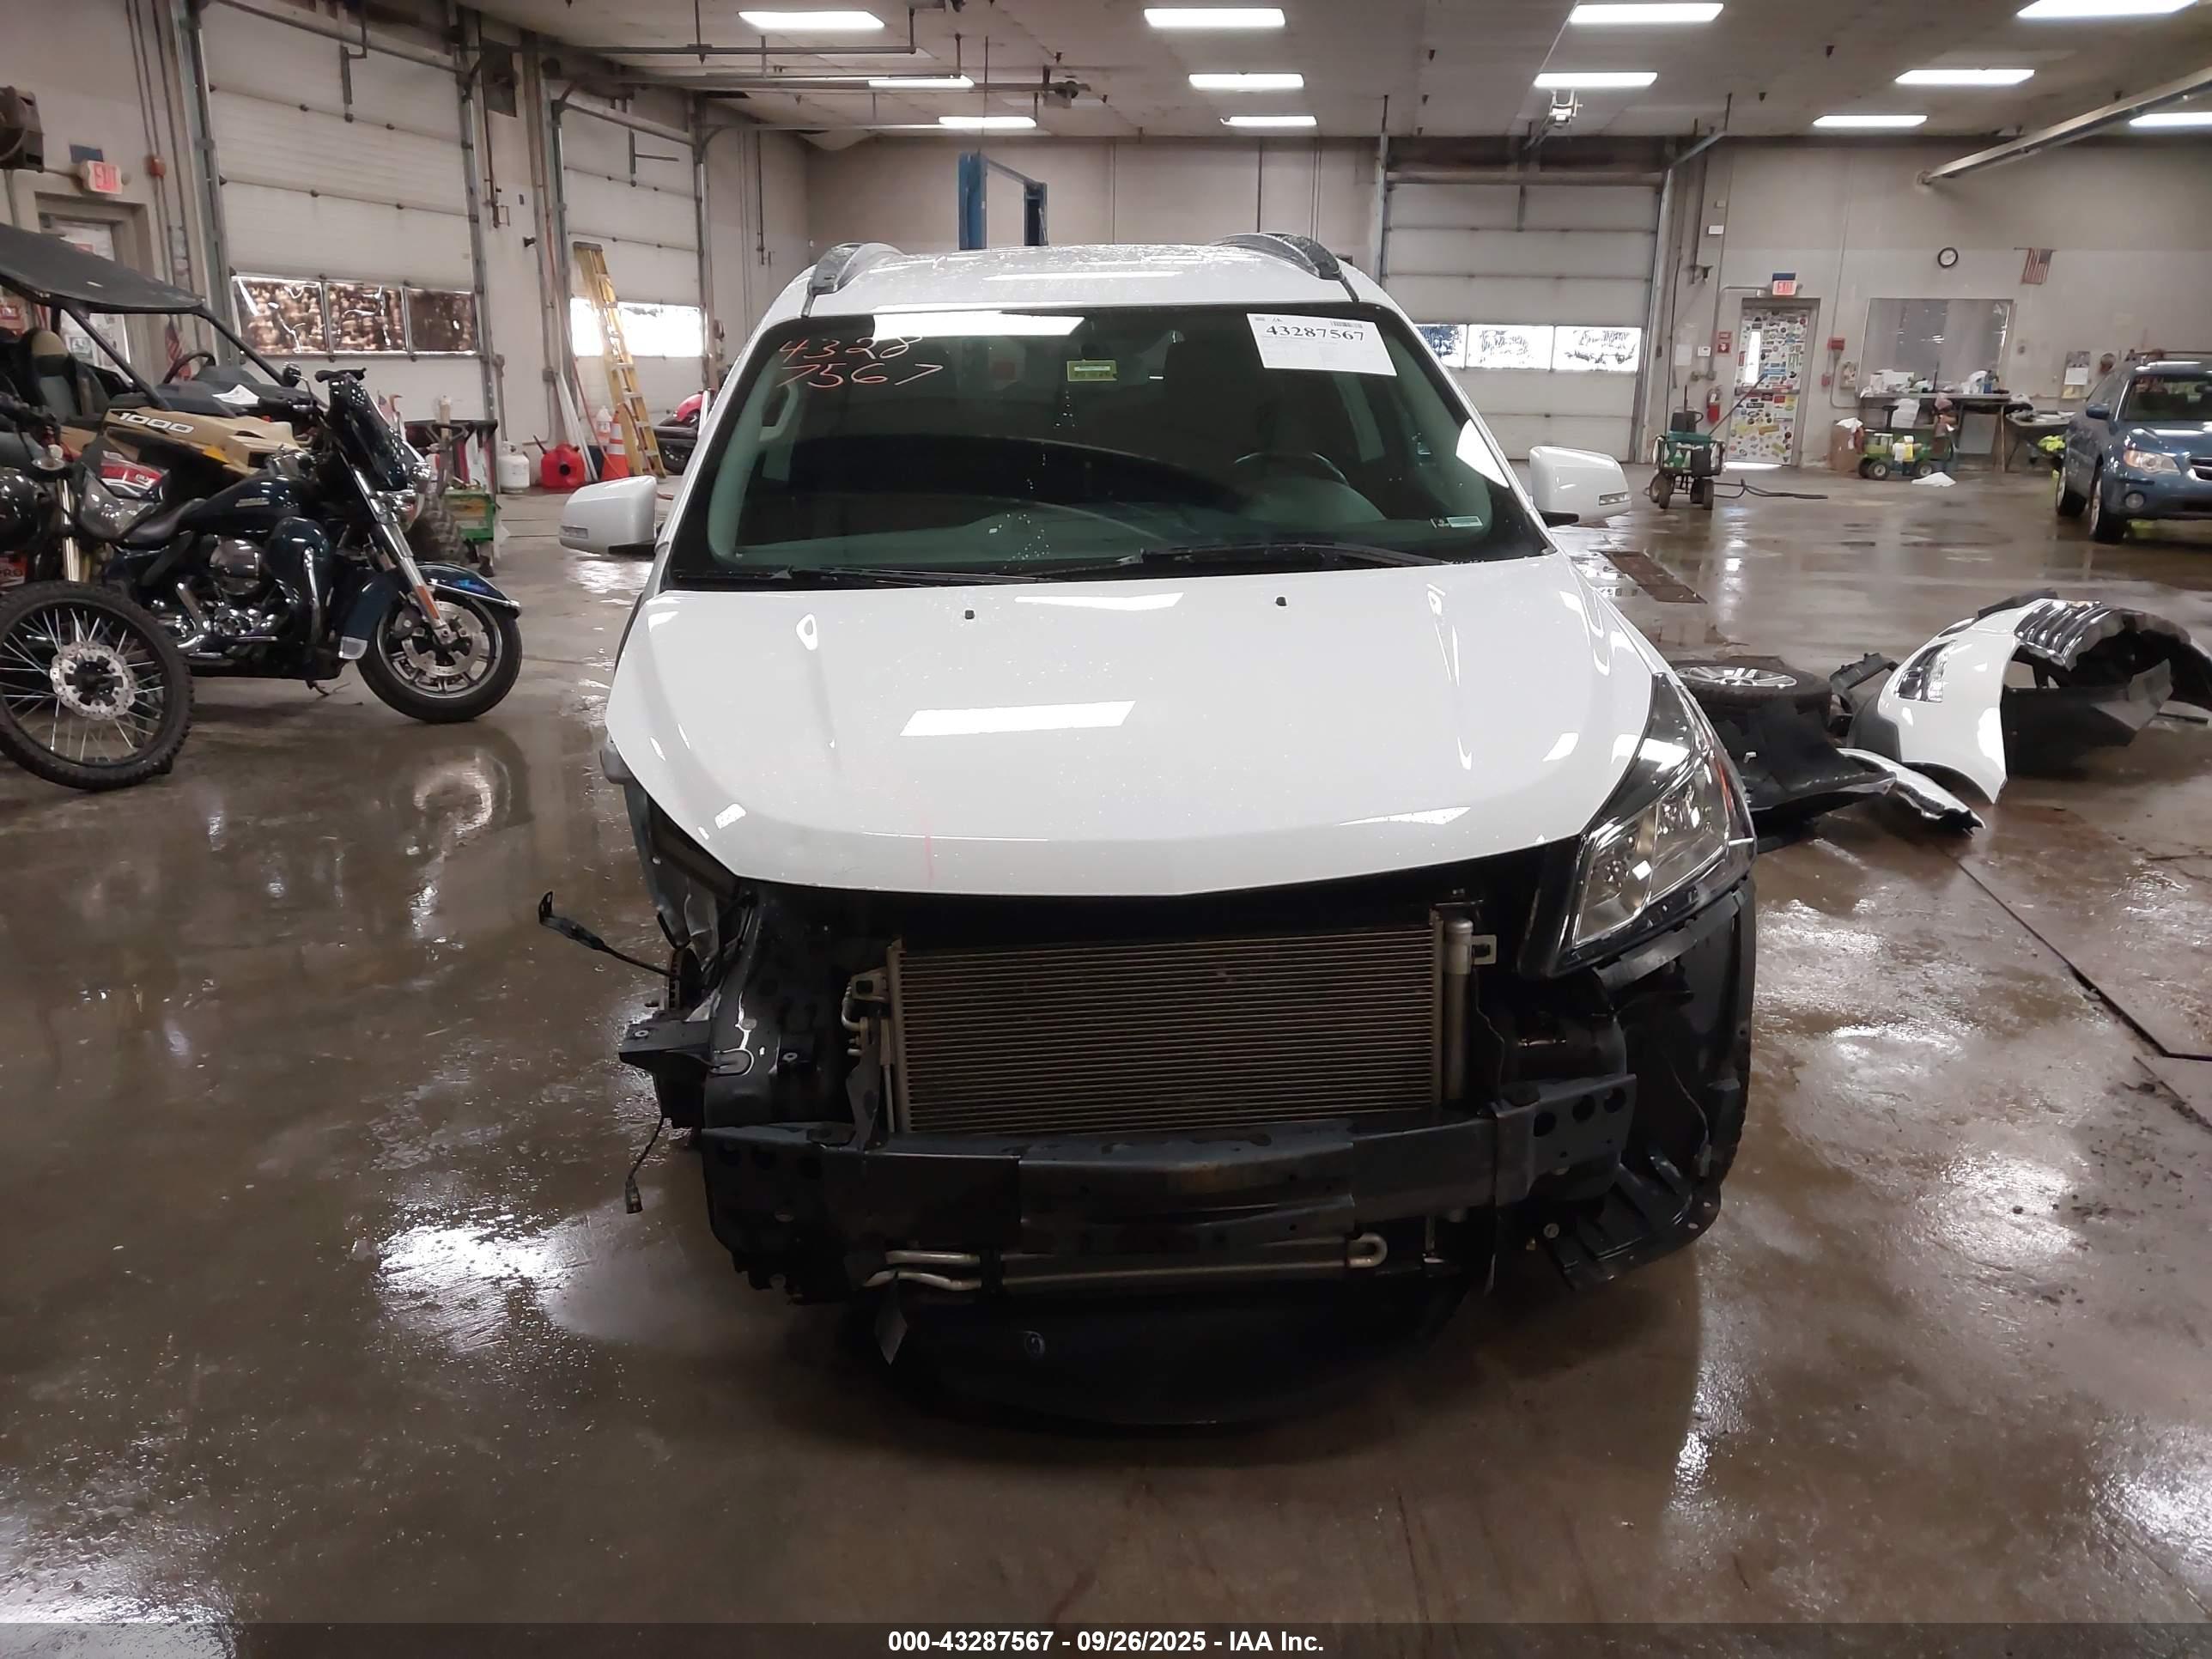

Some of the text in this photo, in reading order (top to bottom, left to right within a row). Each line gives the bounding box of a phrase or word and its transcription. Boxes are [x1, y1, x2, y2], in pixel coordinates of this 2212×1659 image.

[1266, 325, 1364, 341] 43287567
[779, 336, 922, 363] 4328
[776, 362, 943, 387] 7567
[118, 412, 194, 434] 1000
